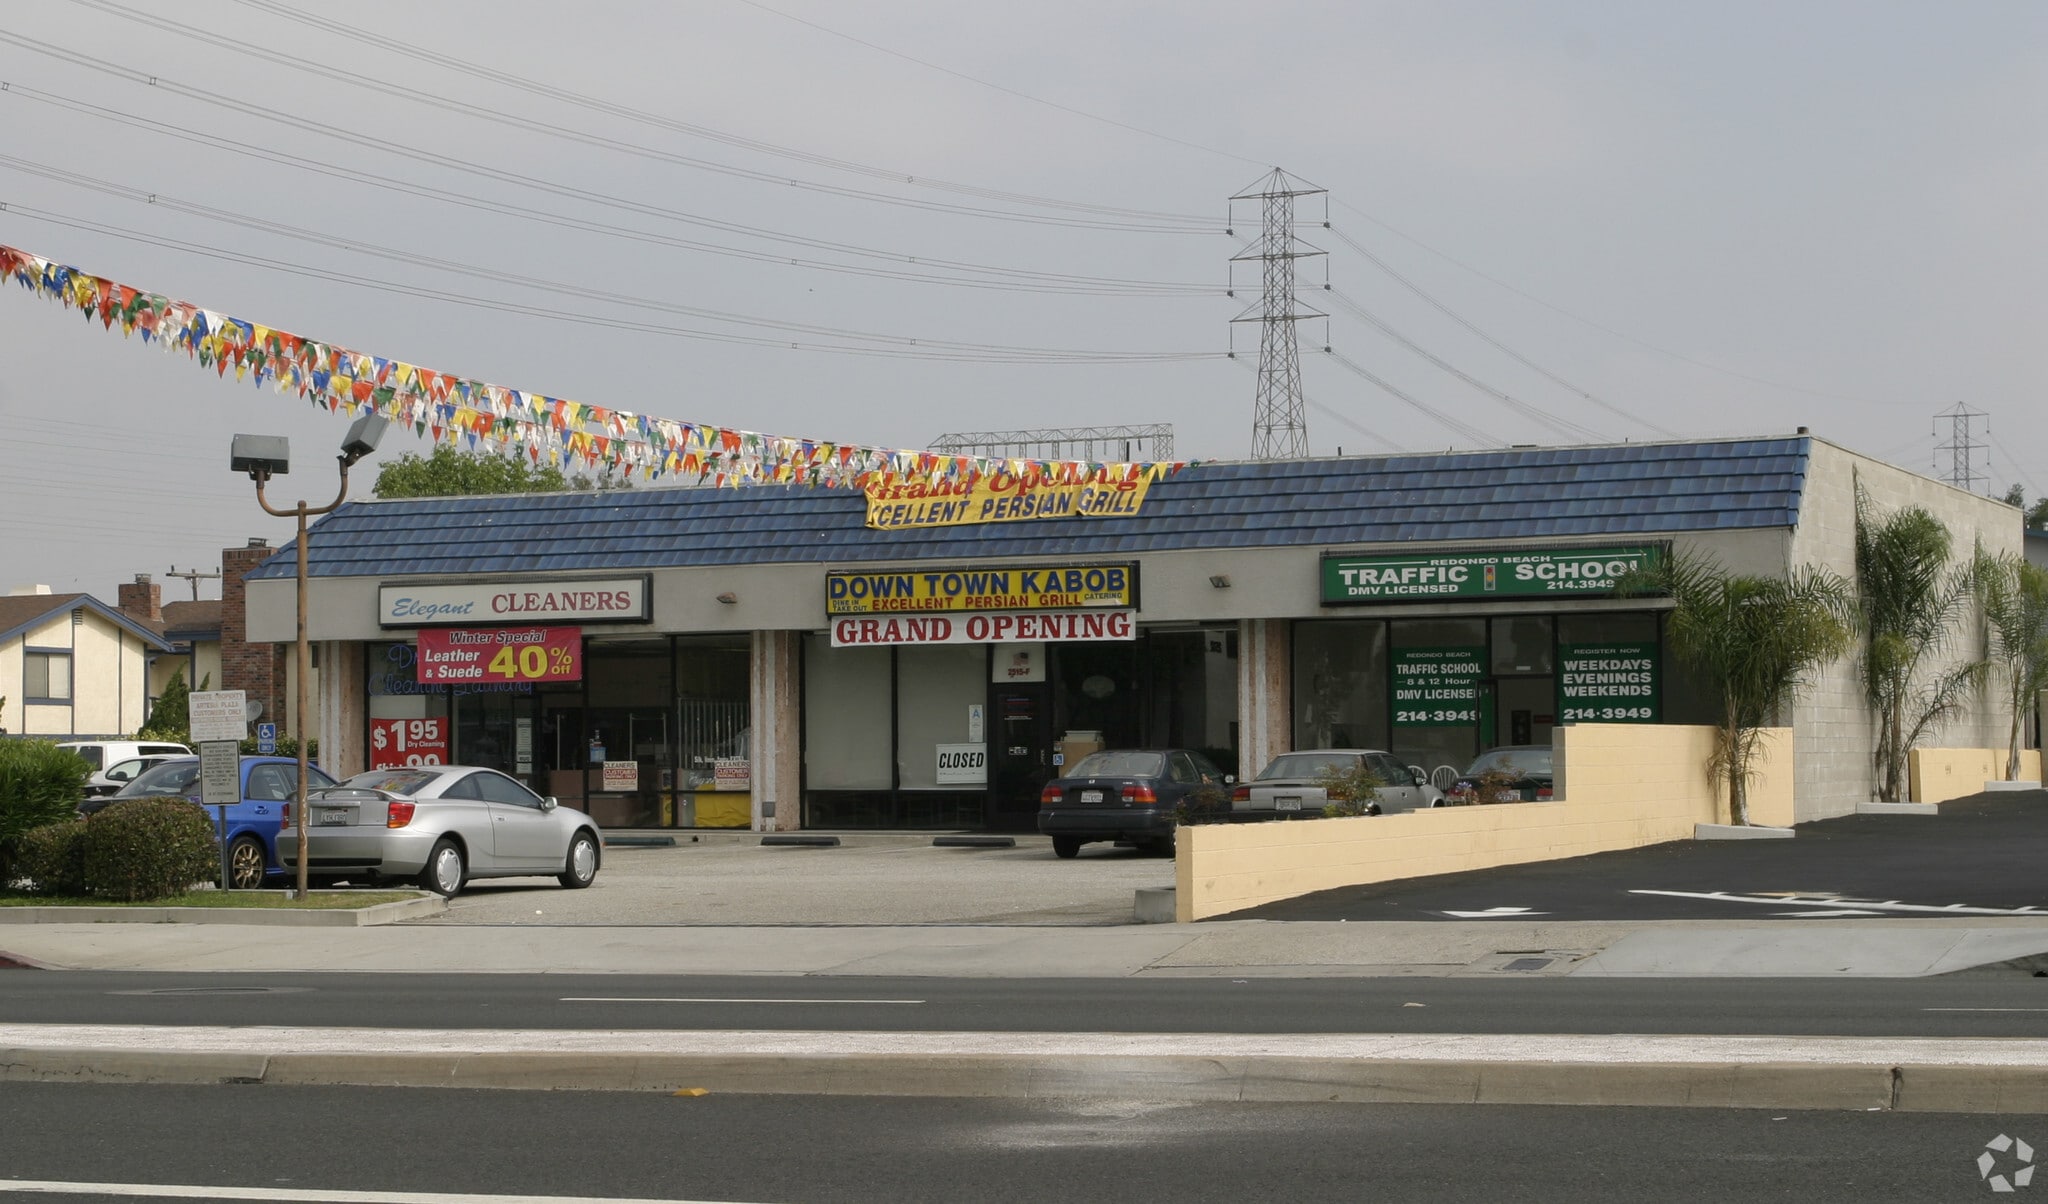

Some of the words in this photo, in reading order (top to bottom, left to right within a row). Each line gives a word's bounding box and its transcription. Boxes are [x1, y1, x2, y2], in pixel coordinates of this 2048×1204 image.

[981, 492, 1072, 520] PERSIAN
[1078, 487, 1137, 513] GRILL
[1430, 558, 1498, 566] REDONDO
[1503, 556, 1550, 564] BEACH
[1338, 566, 1468, 586] TRAFFIC
[830, 575, 914, 600] DOWN
[924, 573, 1009, 597] TOWN
[1021, 569, 1126, 594] KABOB
[1348, 587, 1381, 596] DMV
[1385, 584, 1459, 595] LICENSED
[872, 597, 954, 611] EXCELLENT
[965, 595, 1029, 608] PERSIAN
[1039, 594, 1082, 606] GRILL
[1084, 592, 1123, 600] CATERING
[391, 598, 475, 620] Elegant
[491, 591, 632, 613] CLEANERS
[836, 617, 952, 644] GRAND
[966, 612, 1131, 641] OPENING
[449, 631, 494, 645] Winter
[496, 629, 547, 645] Special
[425, 649, 481, 663] Leather
[425, 669, 434, 679] &
[437, 664, 483, 679] Suede
[1396, 663, 1438, 675] TRAFFIC
[1440, 663, 1481, 674] SCHOOL
[1563, 659, 1652, 671] WEEKDAYS
[1563, 672, 1652, 684] EVENINGS
[1396, 689, 1422, 700] DMV
[1563, 685, 1652, 697] WEEKENDS
[939, 752, 984, 769] CLOSED
